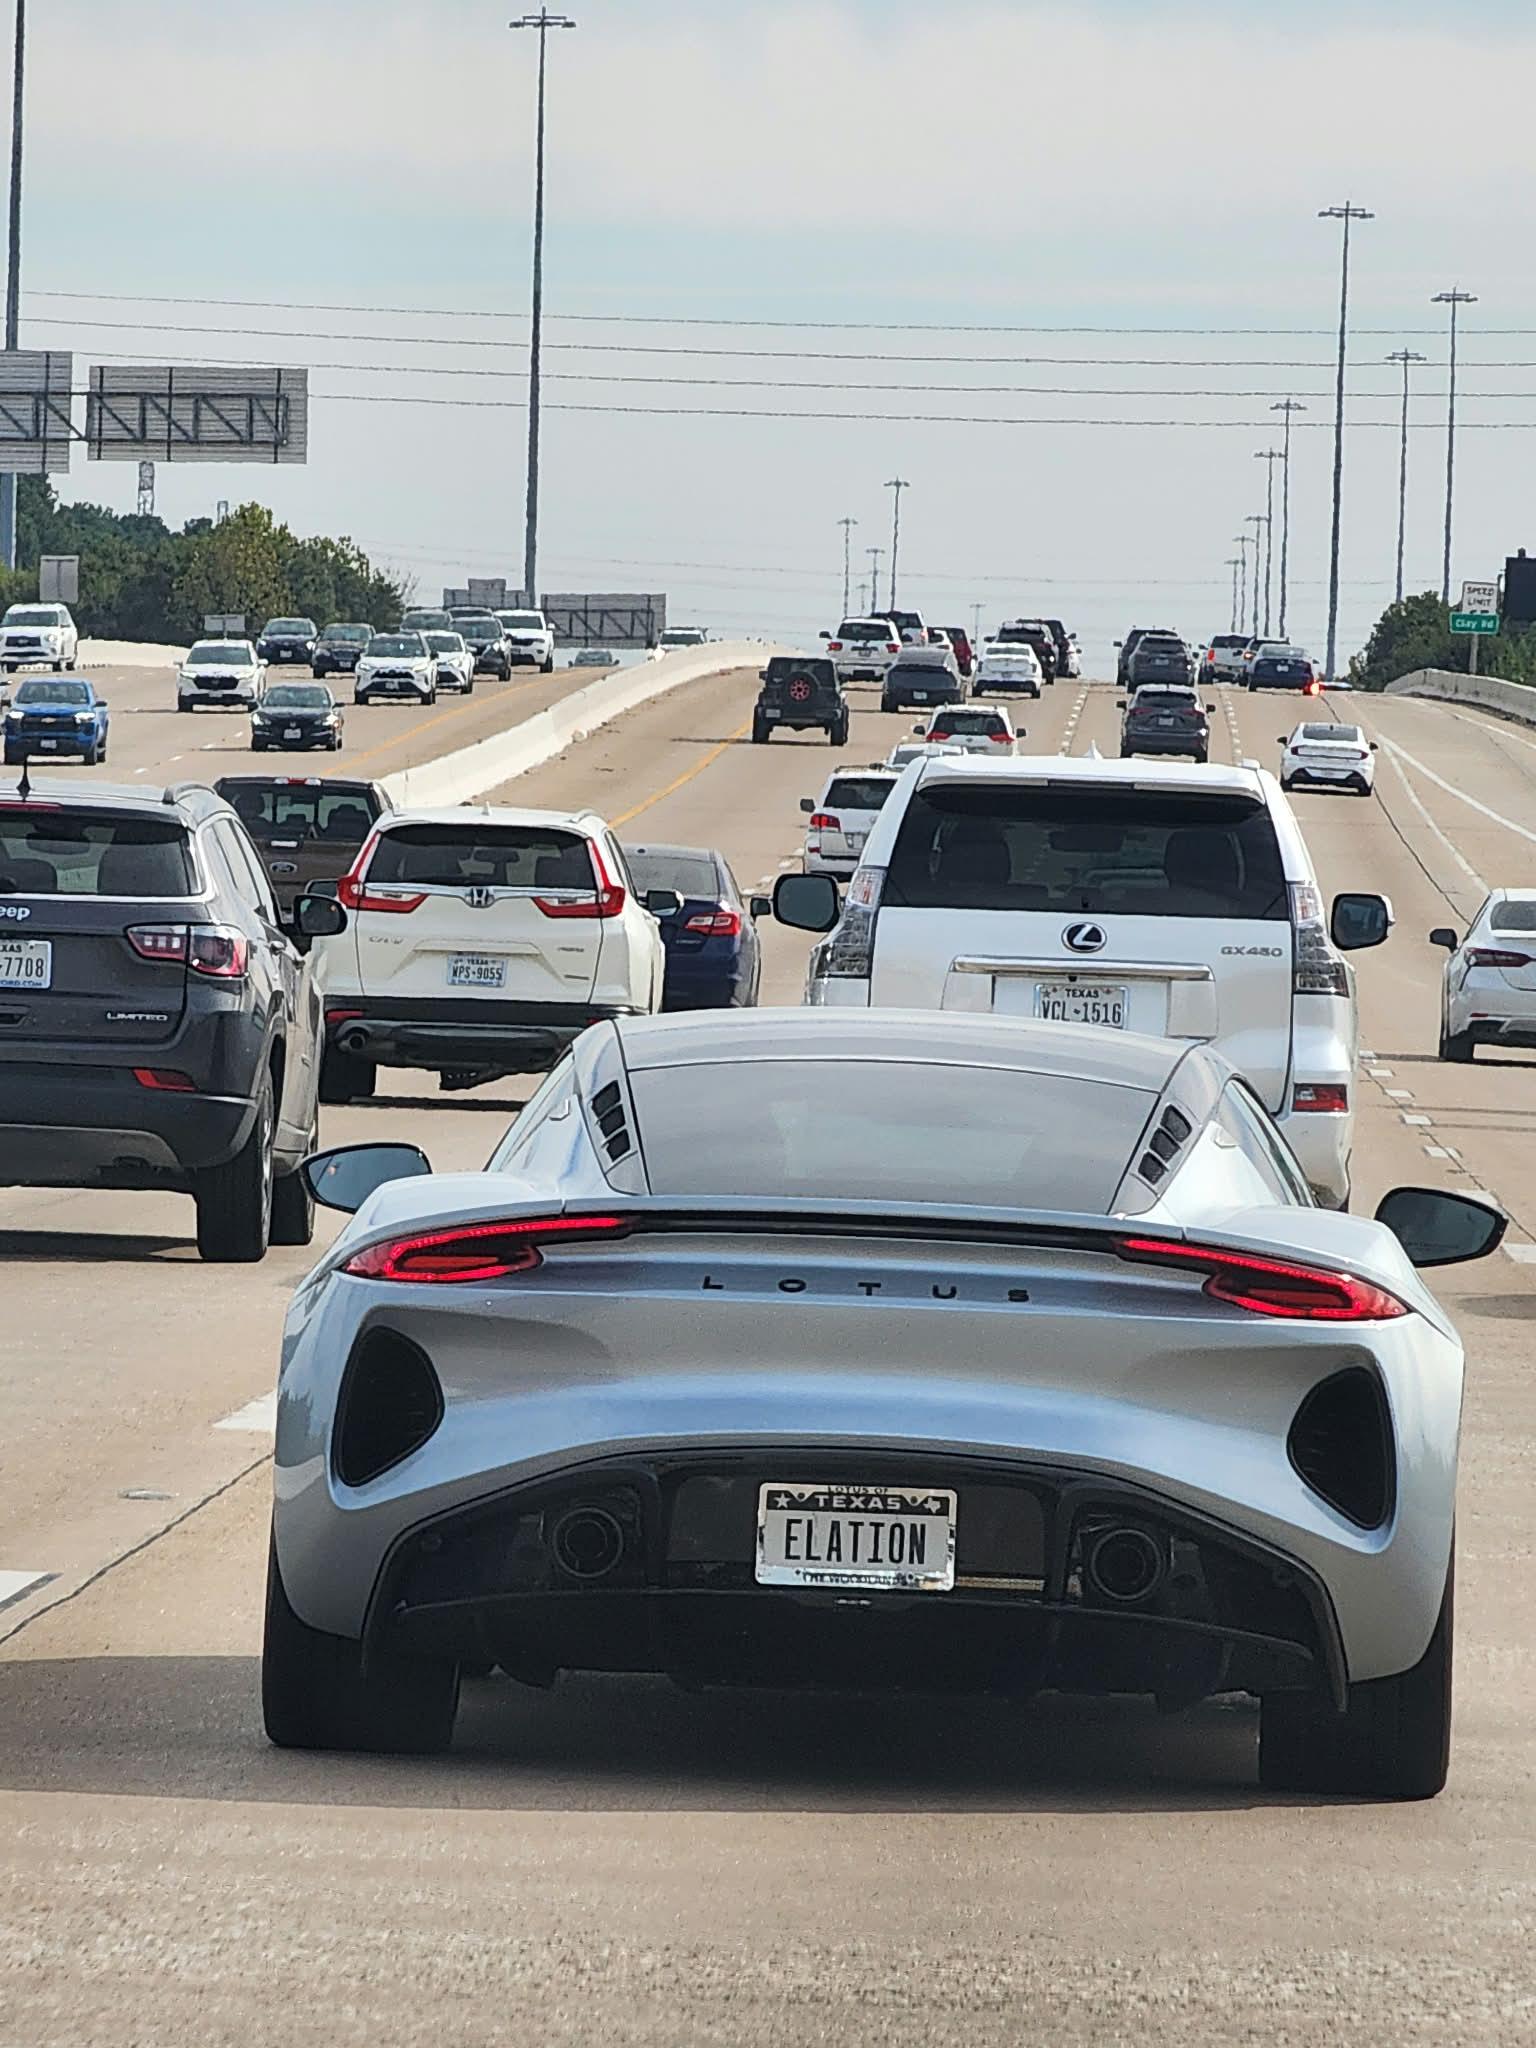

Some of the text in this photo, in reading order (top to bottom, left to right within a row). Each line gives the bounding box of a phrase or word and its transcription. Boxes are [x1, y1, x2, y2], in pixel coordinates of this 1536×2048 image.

[1467, 586, 1495, 596] SPEED
[1467, 598, 1492, 607] LIMIT
[1455, 618, 1494, 629] Clay Rd
[1065, 988, 1099, 998] TEXAS
[107, 1012, 168, 1021] LIMITED
[702, 1275, 1030, 1302] LOTUS
[828, 1485, 869, 1494] LOTUS
[814, 1494, 901, 1510] TEXAS
[784, 1518, 926, 1564] ELATION
